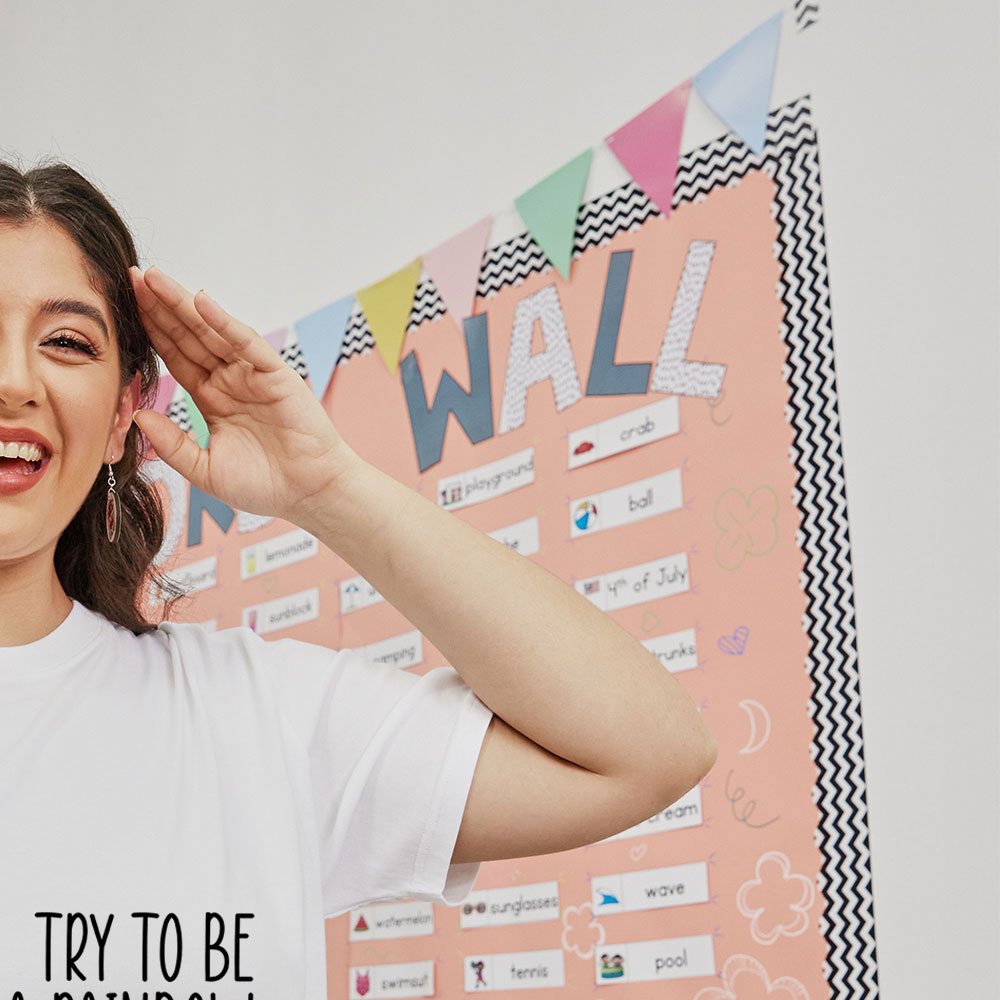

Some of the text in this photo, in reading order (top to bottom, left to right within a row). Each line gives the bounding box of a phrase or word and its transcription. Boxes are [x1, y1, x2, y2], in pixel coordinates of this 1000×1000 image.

[399, 239, 728, 474] WALL
[620, 415, 655, 442] crab
[465, 455, 534, 497] playground
[628, 488, 653, 512] ball
[634, 572, 650, 592] of
[656, 565, 688, 586] July
[644, 882, 685, 899] wave
[490, 894, 558, 916] sunglasses
[376, 912, 431, 928] watermelon
[34, 911, 256, 983] TRY TO BE
[511, 963, 548, 979] tennis
[655, 949, 688, 973] pool
